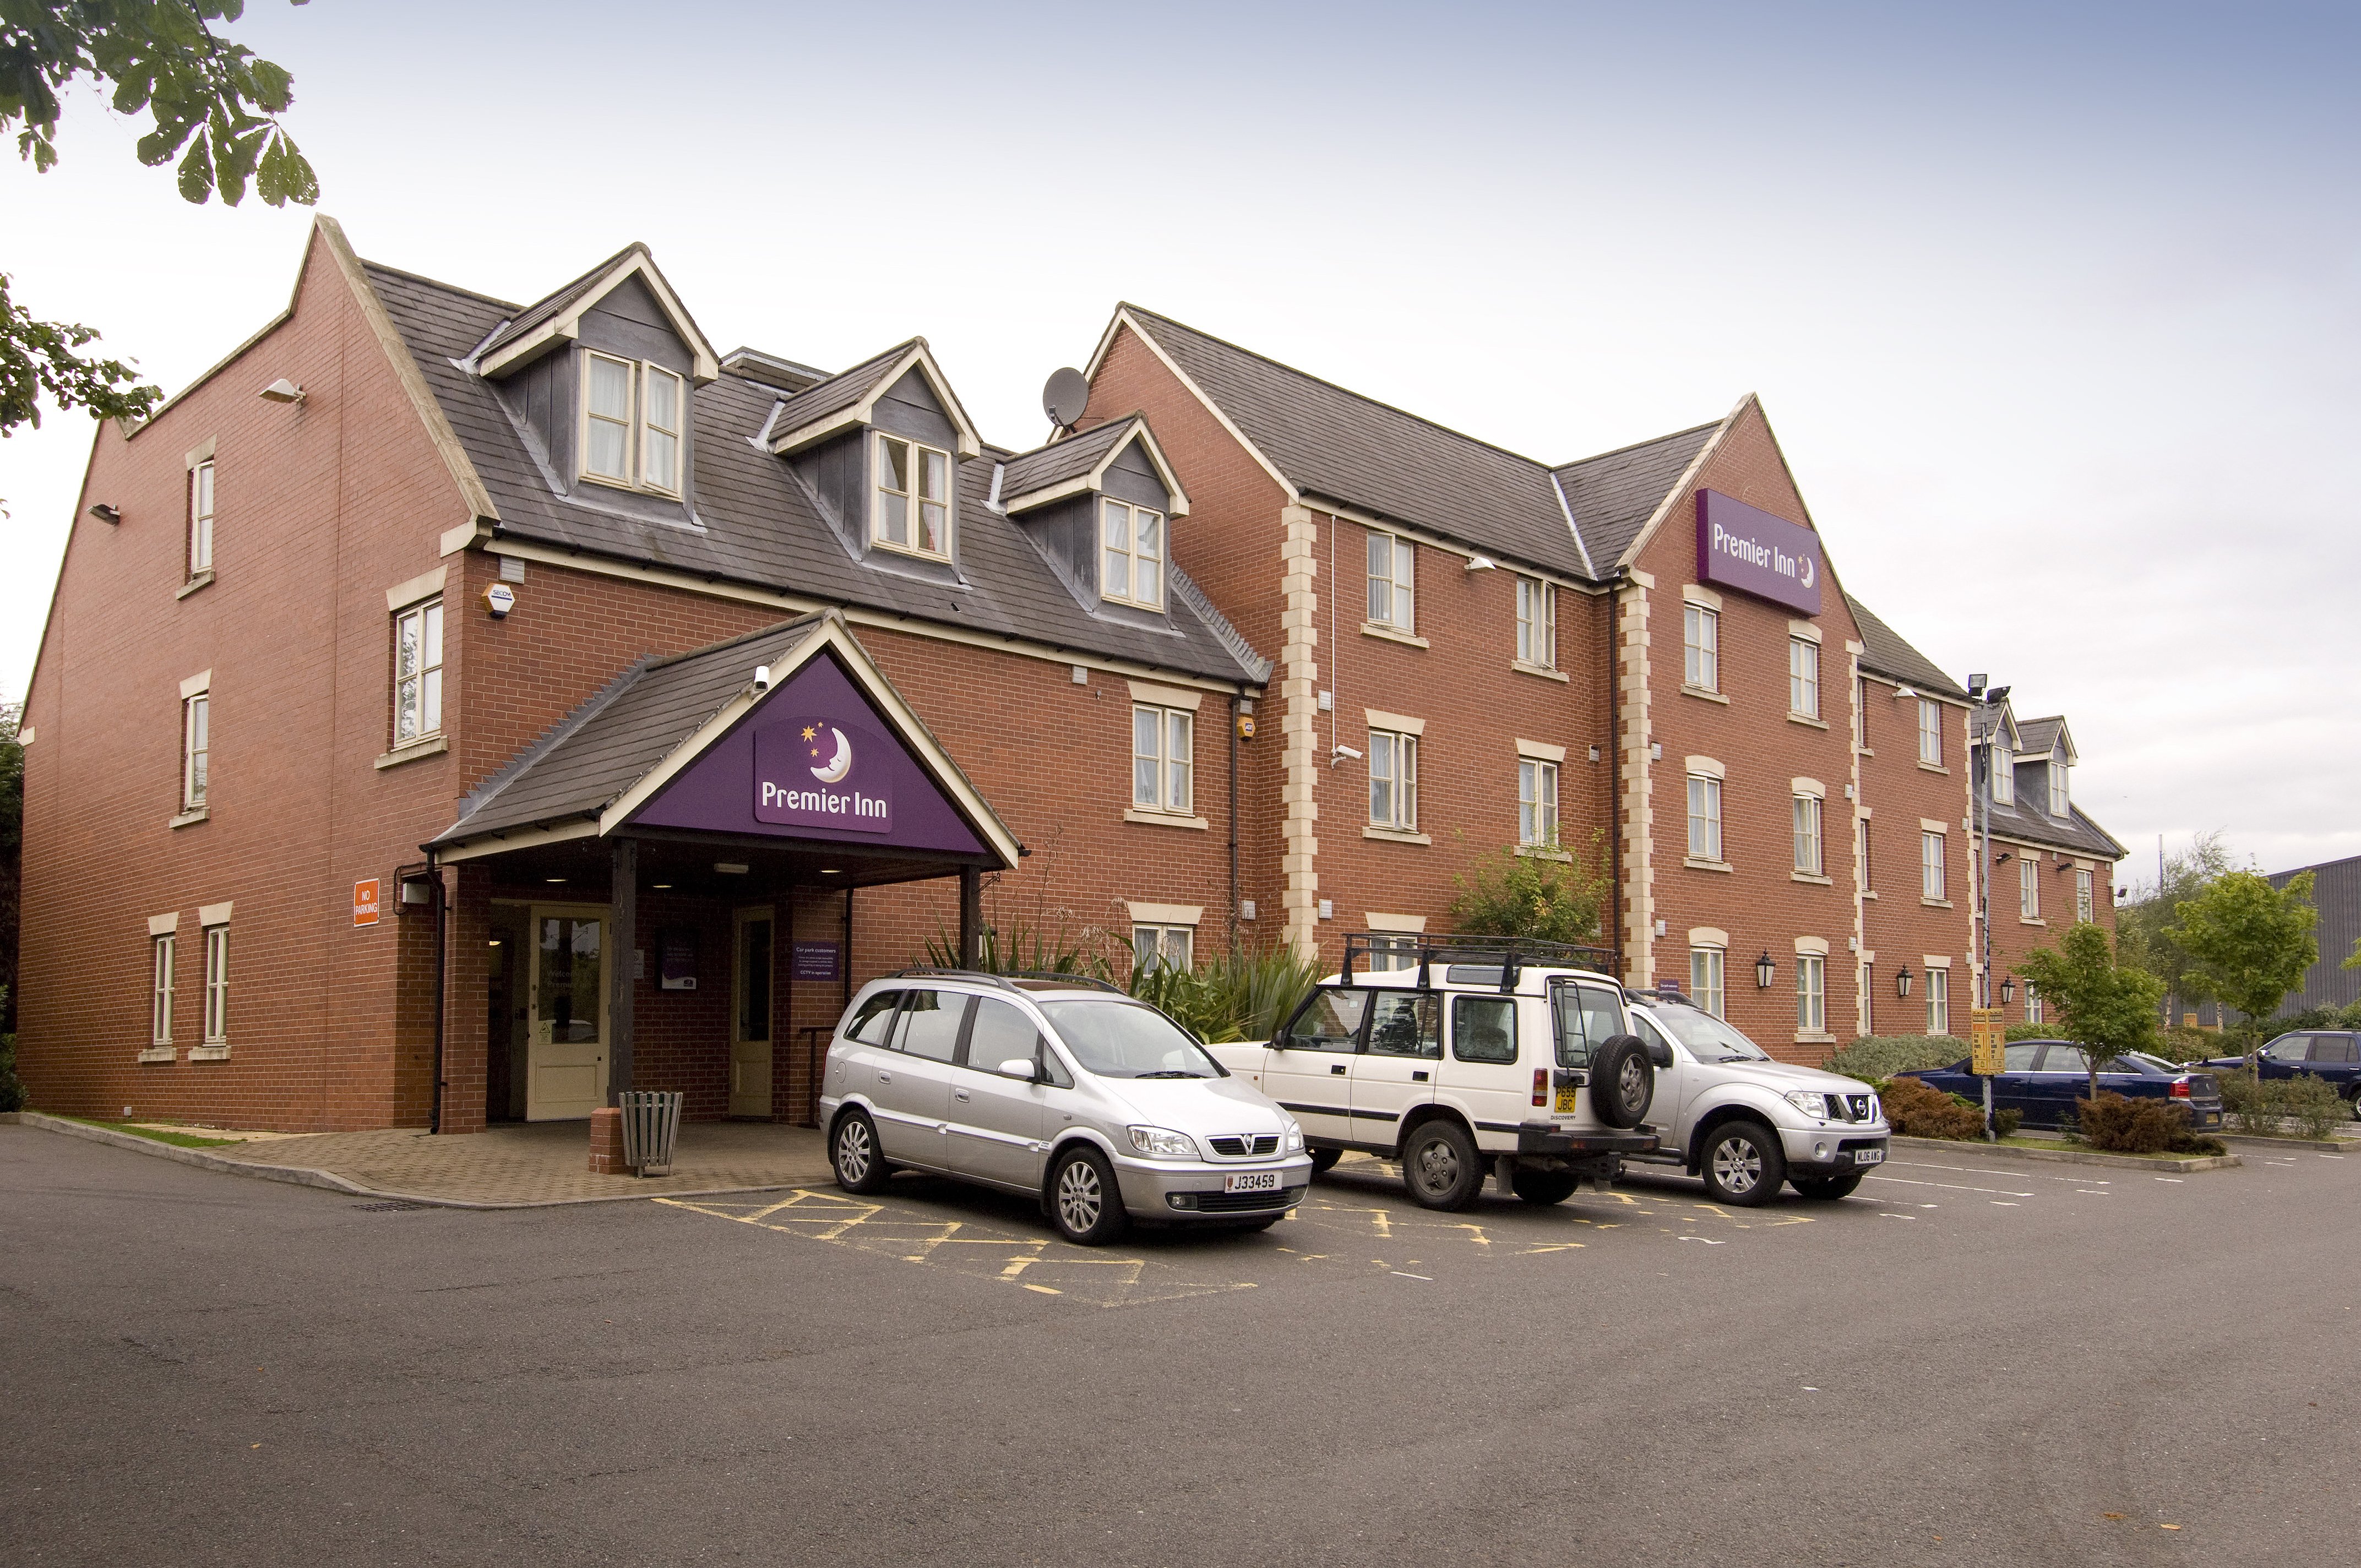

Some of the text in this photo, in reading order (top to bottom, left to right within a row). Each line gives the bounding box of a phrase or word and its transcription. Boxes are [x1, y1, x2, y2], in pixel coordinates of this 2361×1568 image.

[1714, 522, 1796, 578] Premier Inn
[762, 781, 886, 818] Premier Inn
[362, 890, 370, 901] NO
[355, 902, 378, 915] PARKING
[1556, 1086, 1575, 1097] P655
[1558, 1099, 1573, 1110] JBC
[1857, 1151, 1880, 1162] ML06 AWG
[1234, 1174, 1275, 1190] J33459
